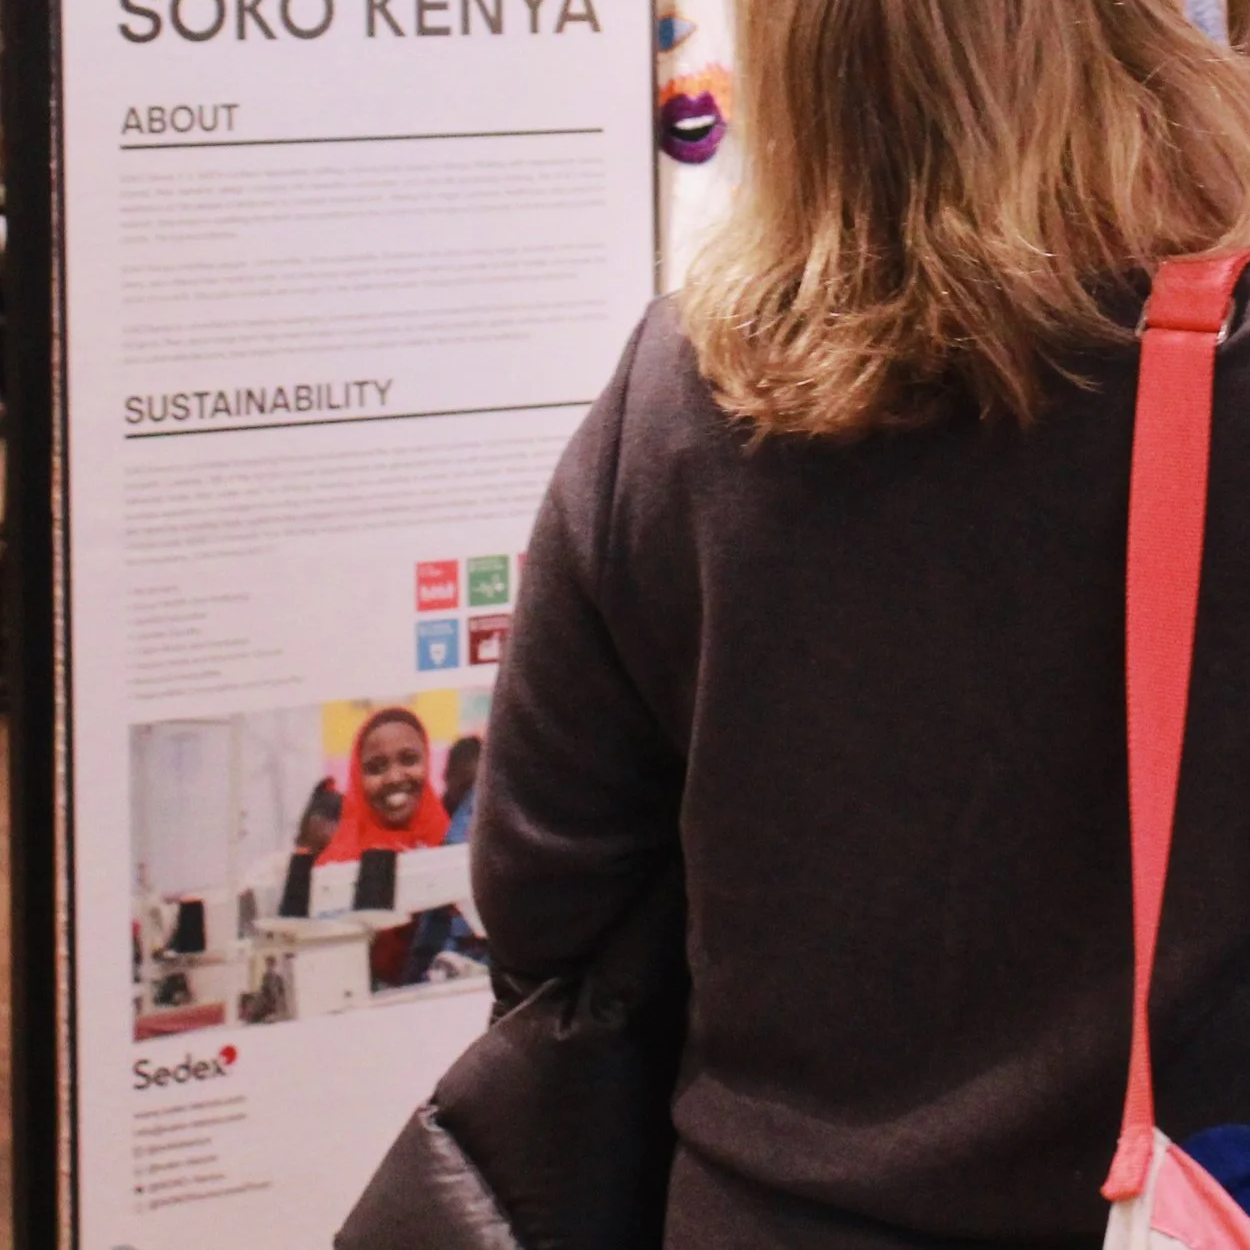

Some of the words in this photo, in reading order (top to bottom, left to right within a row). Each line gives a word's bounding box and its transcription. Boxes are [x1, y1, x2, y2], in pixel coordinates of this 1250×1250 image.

[121, 103, 240, 135] ABOUT
[124, 379, 395, 425] SUSTAINABILITY
[132, 1054, 228, 1091] Sedex
